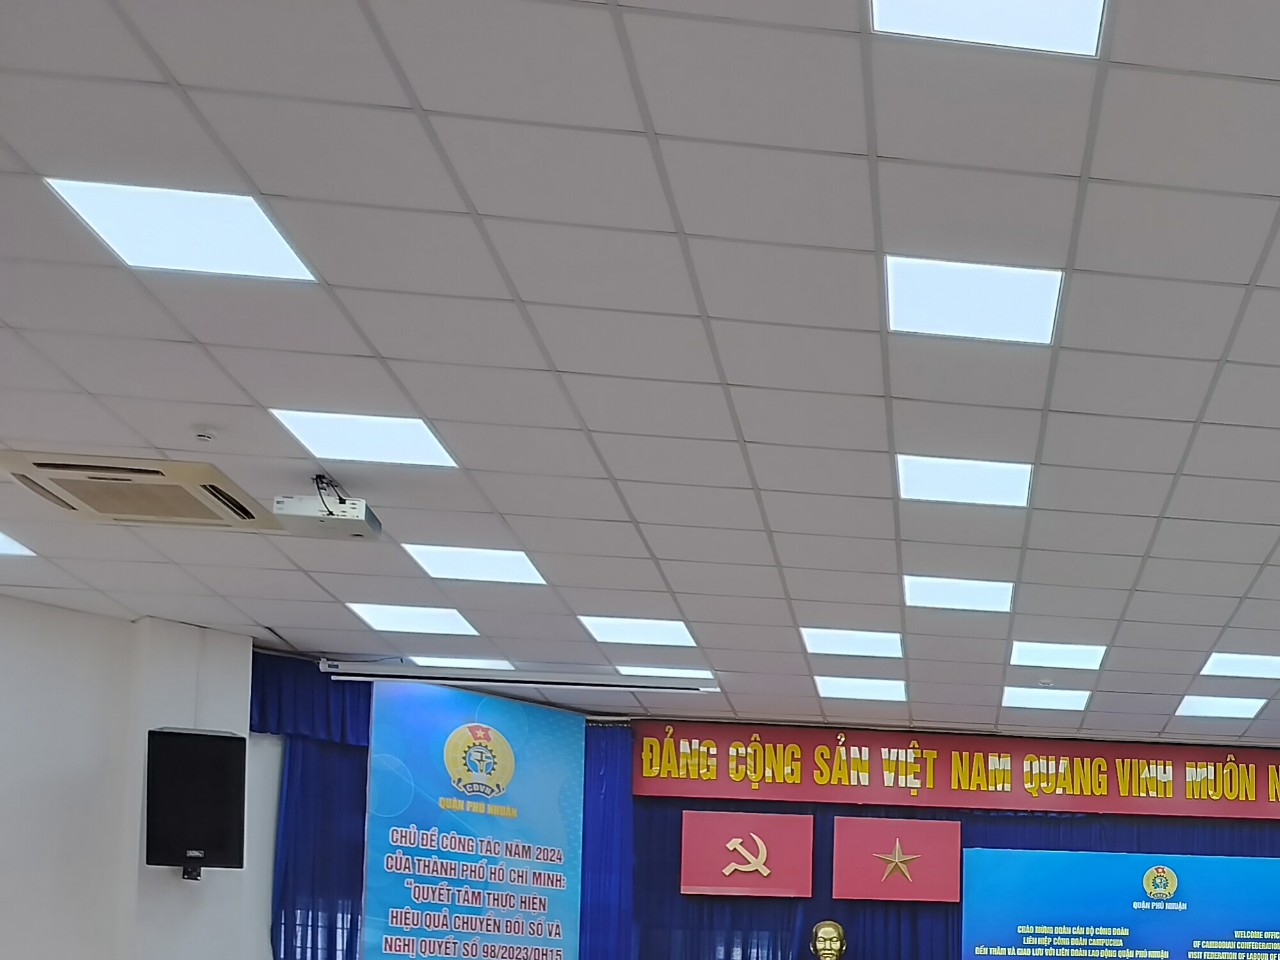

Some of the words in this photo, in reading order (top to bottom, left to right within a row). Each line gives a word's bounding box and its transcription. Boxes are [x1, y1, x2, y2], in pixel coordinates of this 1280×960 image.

[642, 726, 717, 781] ĐẢNG
[729, 734, 802, 789] CỘNG
[813, 733, 869, 786] SẢN
[881, 740, 937, 796] VIỆT
[951, 750, 1011, 792] NAM
[1024, 754, 1107, 797] QUANG
[1115, 758, 1173, 799] VINH
[1186, 754, 1256, 801] MUÔN
[391, 825, 417, 846] CHỦ
[421, 827, 438, 848] ĐỀ
[441, 832, 475, 853] CÔNG
[479, 836, 501, 856] TÁC
[504, 840, 532, 860] NĂM
[535, 846, 563, 864] 2024
[385, 850, 411, 872] CỦA
[415, 857, 457, 878] THÀNH
[461, 859, 487, 880] PHỐ
[489, 862, 506, 882] HỒ
[509, 868, 528, 885] CHÍ
[532, 871, 566, 889] MINH:
[456, 885, 482, 907] TÂM
[486, 891, 516, 912] THỰC
[519, 893, 548, 914] HIỆN
[1133, 901, 1150, 911] QUẬN
[1151, 901, 1164, 910] PHÚ
[1165, 902, 1187, 911] NHUẬN
[389, 907, 420, 931] HIỆU
[424, 908, 449, 930] QUẢ
[453, 911, 502, 934] CHUYỂN
[505, 914, 525, 935] ĐỔI
[528, 916, 545, 937] SỐ
[547, 920, 562, 939] VÀ
[383, 936, 416, 958] NGHỊ
[419, 936, 458, 957] QUYẾT
[462, 937, 480, 958] SỐ
